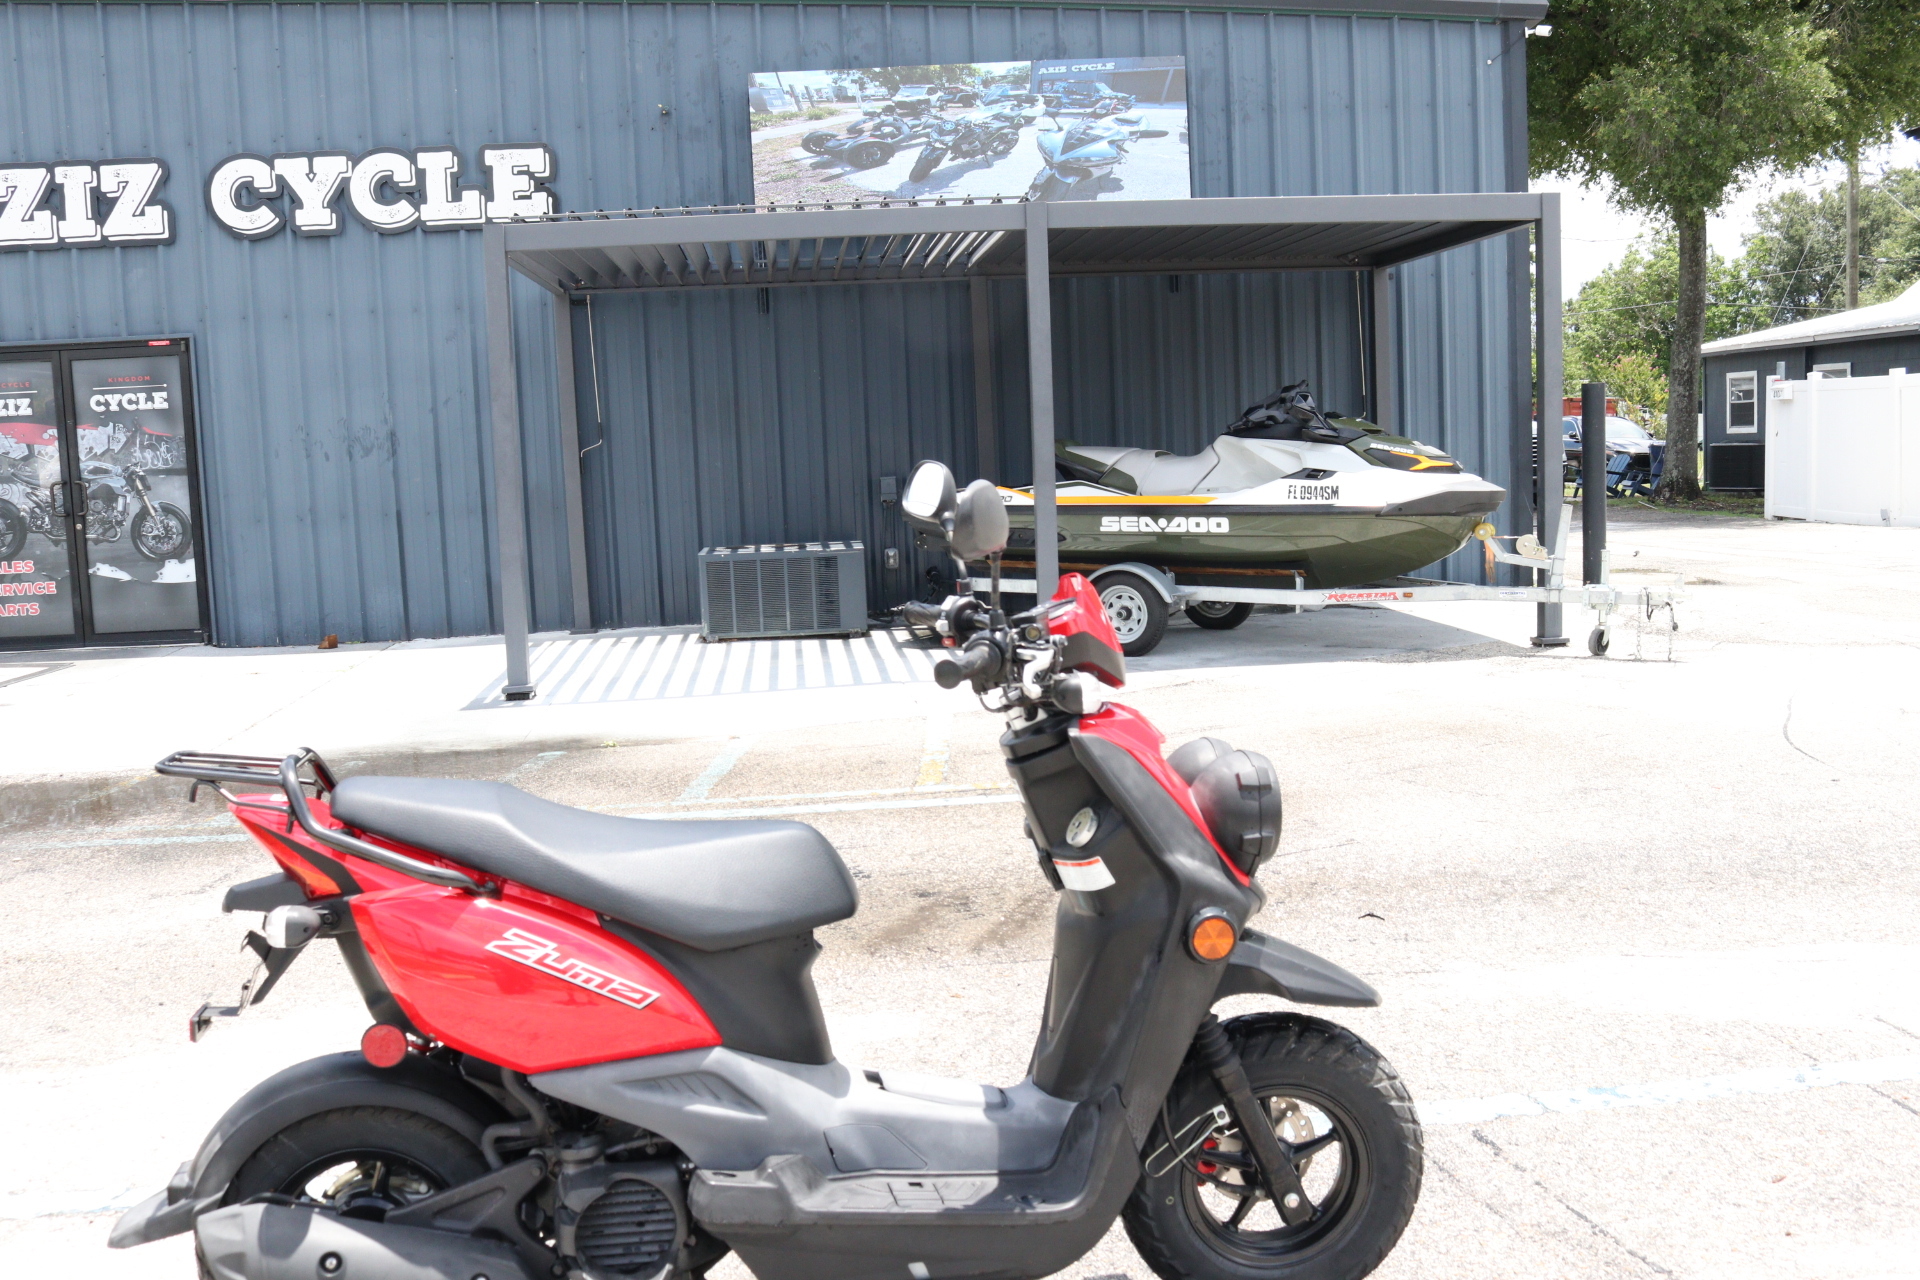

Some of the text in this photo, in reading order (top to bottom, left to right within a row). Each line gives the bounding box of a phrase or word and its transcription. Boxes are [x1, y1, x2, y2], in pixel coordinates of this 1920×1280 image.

[1038, 62, 1115, 74] AZIZ CYCLE
[209, 147, 555, 234] CYCLE
[89, 391, 169, 412] CYCLE
[0, 560, 35, 574] LES
[0, 581, 57, 596] RVICE
[1326, 591, 1399, 602] ROCKSTAR
[484, 927, 661, 1010] Zuma
